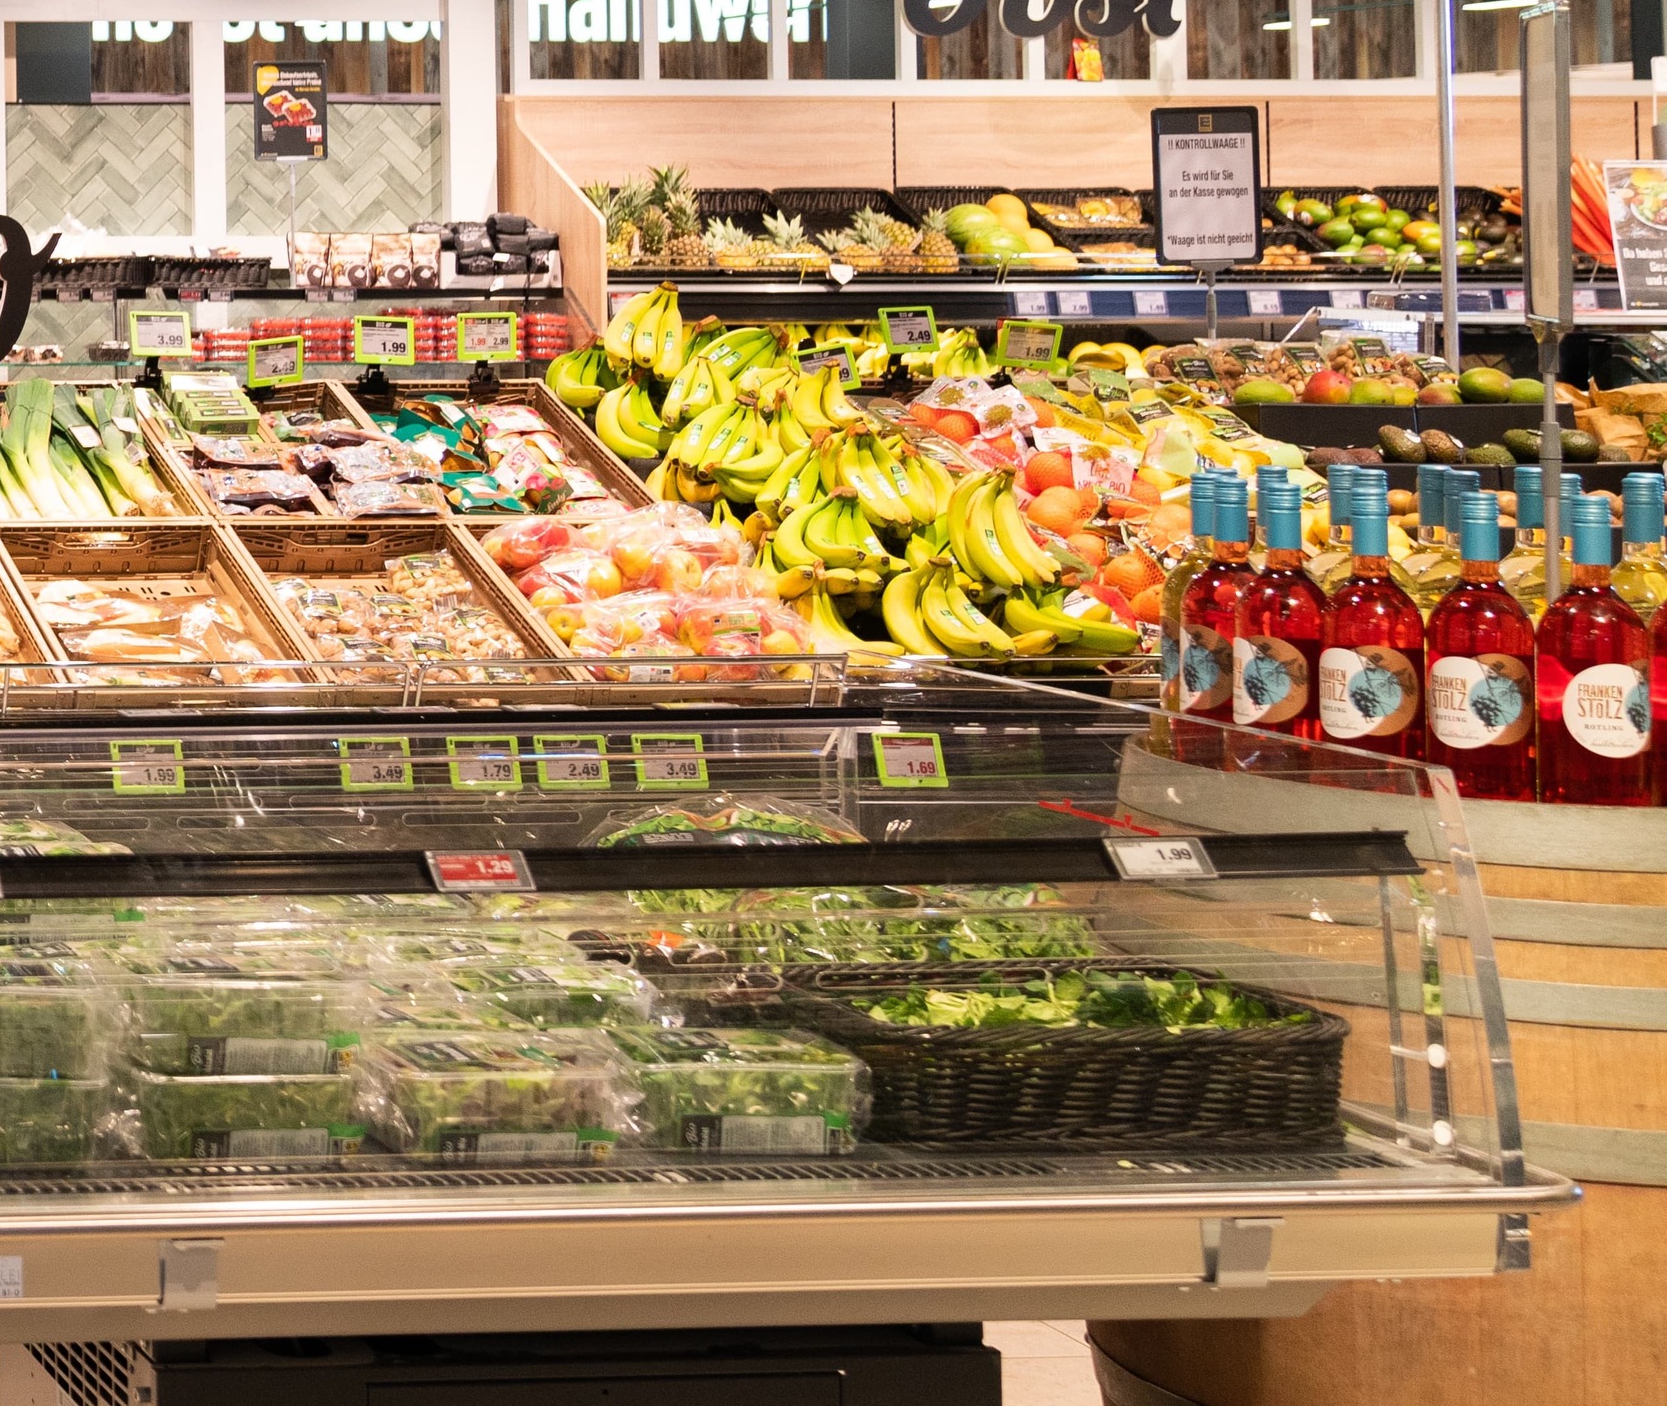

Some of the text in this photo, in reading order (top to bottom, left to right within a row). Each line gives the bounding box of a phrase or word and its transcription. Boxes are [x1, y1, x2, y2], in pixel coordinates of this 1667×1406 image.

[1175, 138, 1238, 150] KONTROLLWAAGE
[1182, 169, 1234, 181] Es wird für Sie
[1169, 187, 1248, 199] an der Kasse gewogen
[1196, 234, 1206, 244] ist
[1207, 234, 1226, 244] nicht
[1227, 233, 1253, 245] geeicht
[157, 335, 183, 345] 3.99
[470, 337, 509, 346] 1.99 2.99
[907, 330, 931, 341] 2.49
[381, 342, 406, 353] 1.99
[1024, 347, 1050, 358] 1.99
[272, 361, 295, 374] 2.49
[1578, 683, 1623, 699] FRANKEN
[1578, 698, 1623, 719] STOLZ
[373, 766, 403, 779] 3.49
[482, 765, 511, 778] 1.79
[568, 763, 599, 776] 2.49
[666, 763, 696, 776] 3.49
[907, 761, 936, 774] 1.69
[145, 769, 175, 782] 1.99
[1156, 848, 1193, 861] 1.99
[476, 860, 513, 874] 1.29
